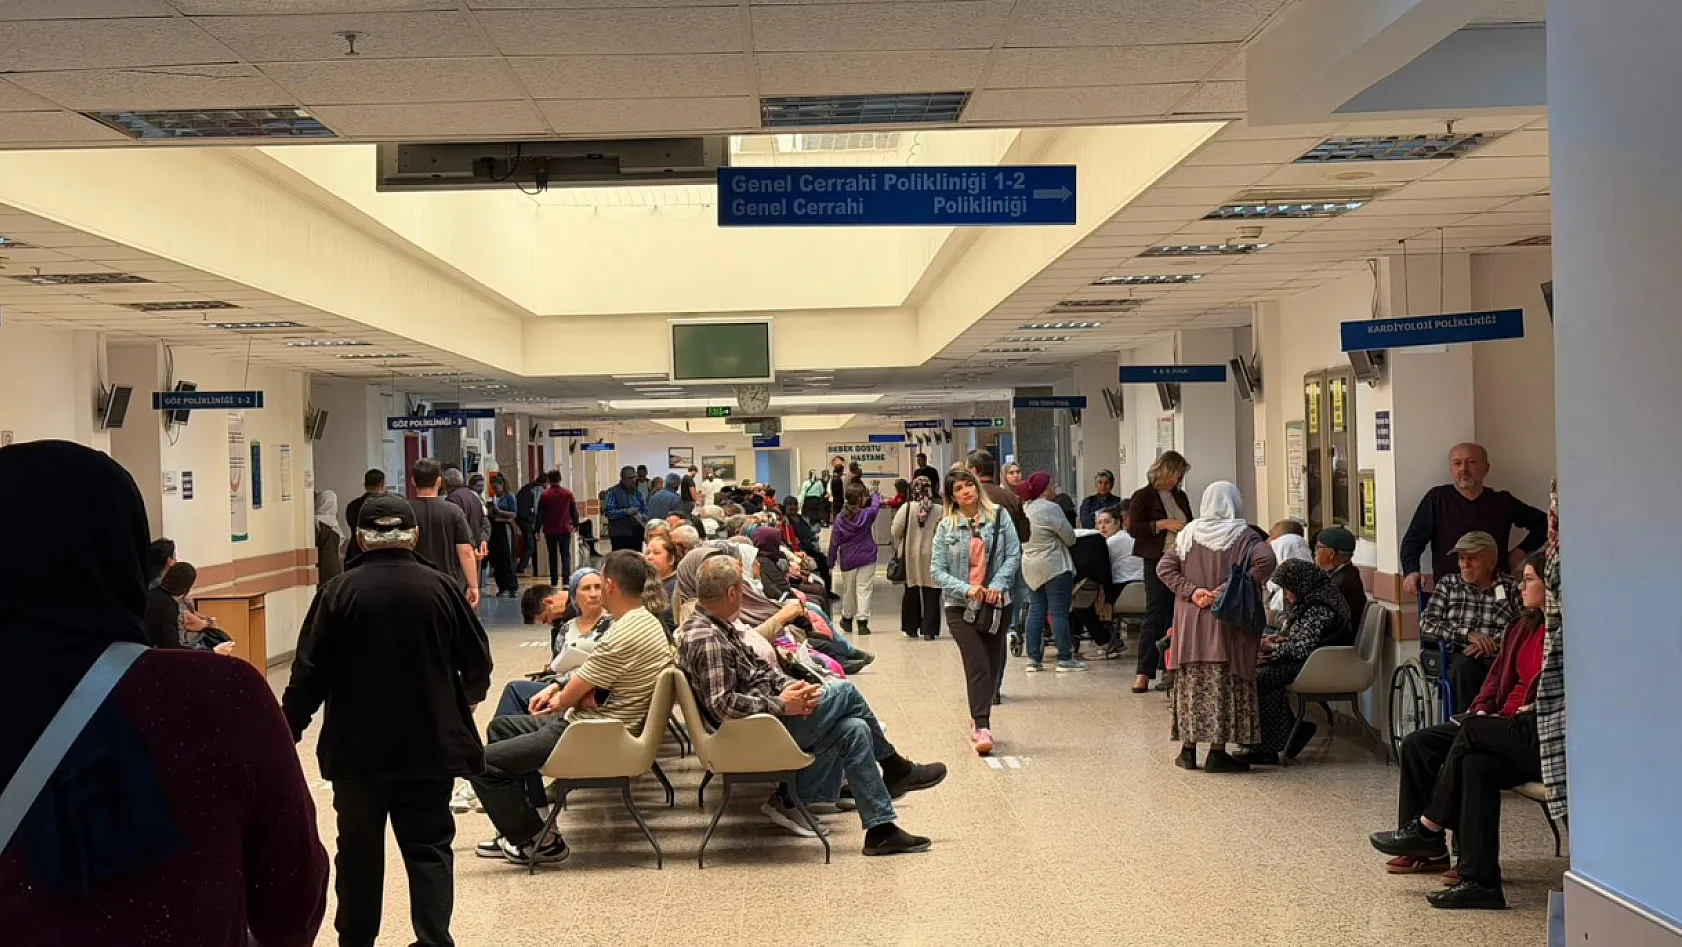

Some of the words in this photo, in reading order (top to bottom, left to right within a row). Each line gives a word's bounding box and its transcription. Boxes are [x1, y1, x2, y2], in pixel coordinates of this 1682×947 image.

[731, 174, 792, 193] Genel
[799, 173, 877, 192] Cerrahi
[883, 172, 986, 194] Polikliniği
[994, 171, 1026, 190] 1-2
[731, 198, 787, 215] Genel
[793, 198, 864, 215] Cerrahi
[934, 196, 1027, 217] Polikliniği
[851, 453, 885, 461] HASTANE
